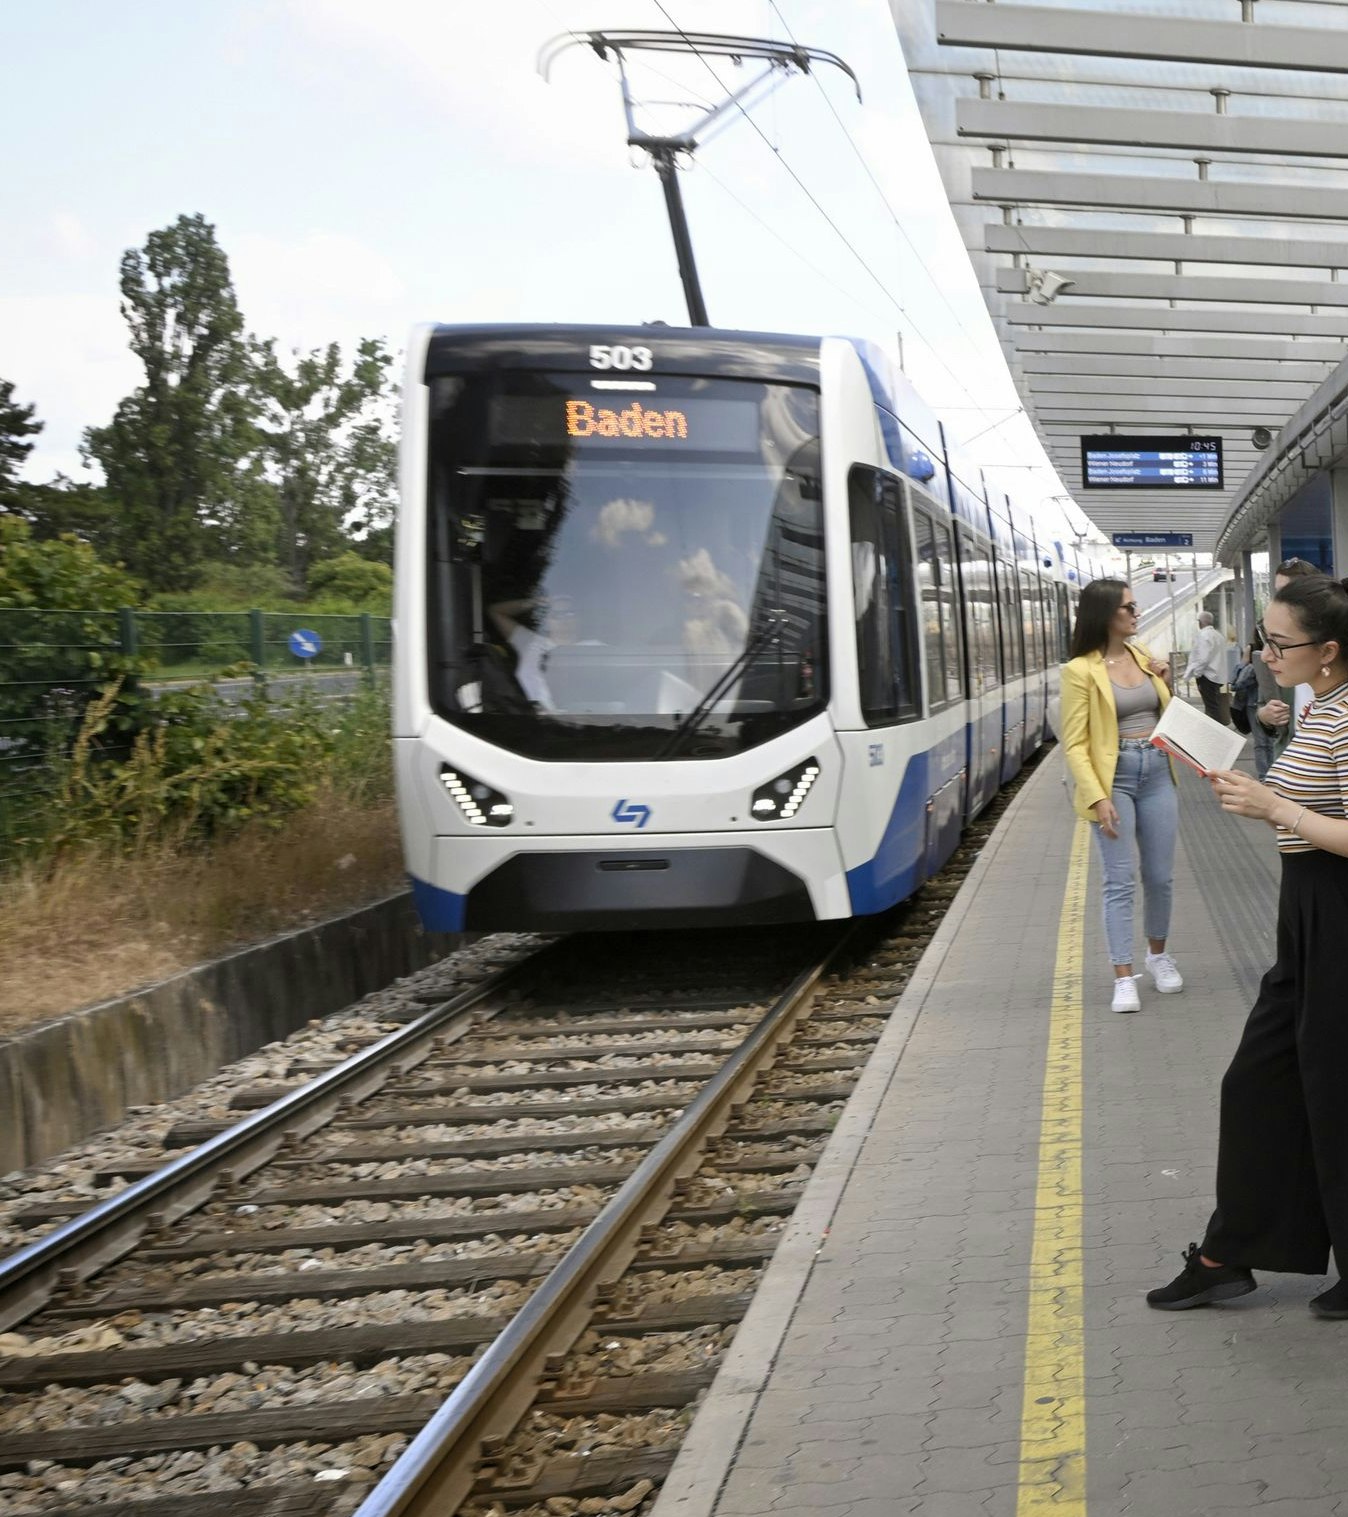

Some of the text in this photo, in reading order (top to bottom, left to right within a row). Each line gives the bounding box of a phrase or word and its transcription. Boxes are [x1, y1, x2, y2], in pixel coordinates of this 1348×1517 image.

[589, 345, 653, 371] 503
[565, 400, 688, 438] Baden
[1190, 441, 1217, 451] 10:45
